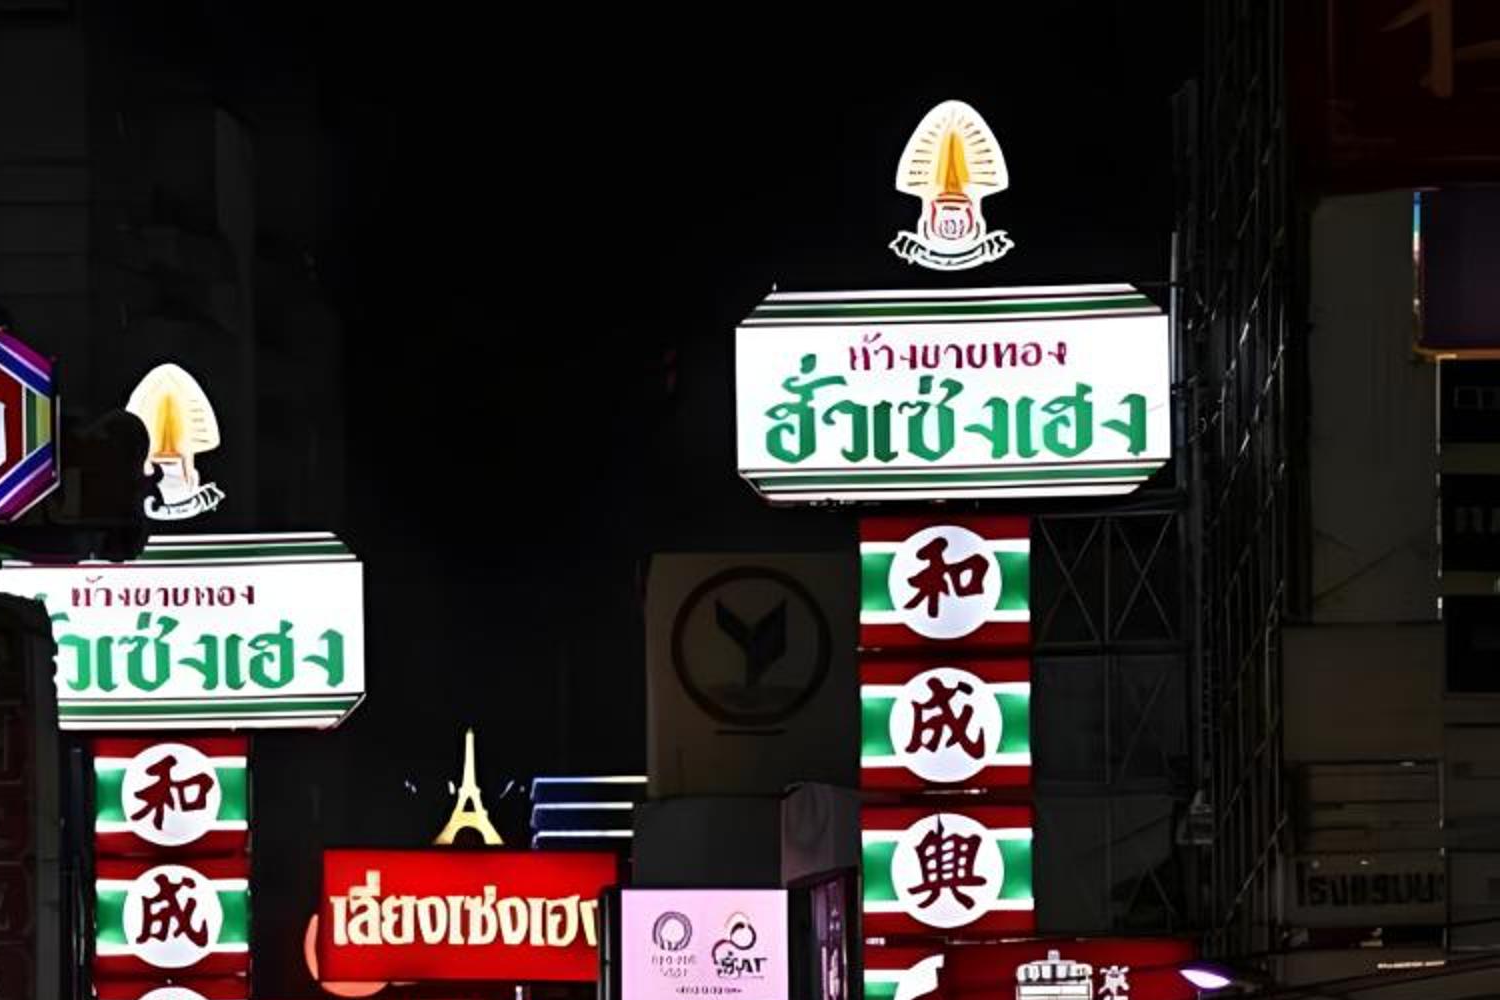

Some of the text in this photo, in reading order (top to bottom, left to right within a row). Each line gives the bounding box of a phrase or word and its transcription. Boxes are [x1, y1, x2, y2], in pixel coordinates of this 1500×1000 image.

[849, 333, 1067, 370] ห้างขายทอง
[71, 576, 255, 607] ห้างขายทอง
